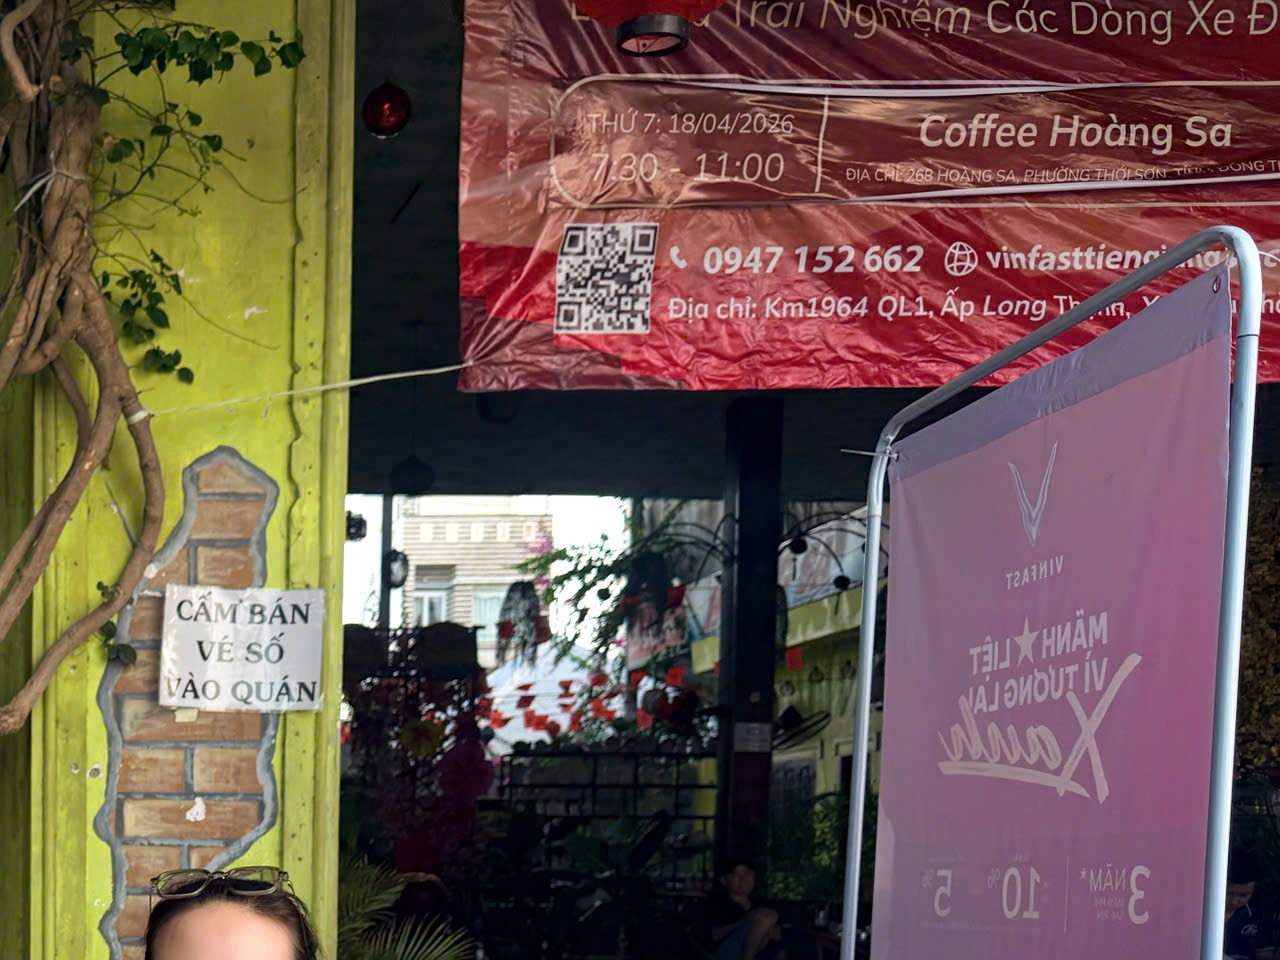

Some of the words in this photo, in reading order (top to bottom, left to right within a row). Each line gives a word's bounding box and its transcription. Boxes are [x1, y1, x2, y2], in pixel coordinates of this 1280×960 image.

[987, 0, 1059, 35] Các
[1071, 2, 1172, 45] Dòng
[1186, 1, 1234, 36] Xe
[586, 108, 637, 134] THỨ
[668, 113, 796, 135] 18/04/2026
[920, 113, 1038, 148] Coffee
[1049, 110, 1173, 156] Hoàng
[1185, 115, 1233, 148] Sa
[592, 153, 659, 182] 7:30
[693, 152, 785, 183] 11:00
[702, 246, 784, 274] 0947
[794, 245, 856, 274] 152
[863, 245, 925, 273] 662
[668, 297, 709, 324] Địa
[716, 297, 757, 319] chỉ:
[764, 296, 869, 319] Km1964
[877, 295, 934, 321] QL1,
[940, 286, 975, 322] Ấp
[983, 295, 1047, 322] Long
[176, 591, 237, 625] CẤM
[247, 597, 311, 625] BÁN
[196, 635, 234, 664] VÉ
[244, 632, 286, 665] SỐ
[166, 671, 221, 701] VÀO
[230, 675, 318, 705] QUÁN
